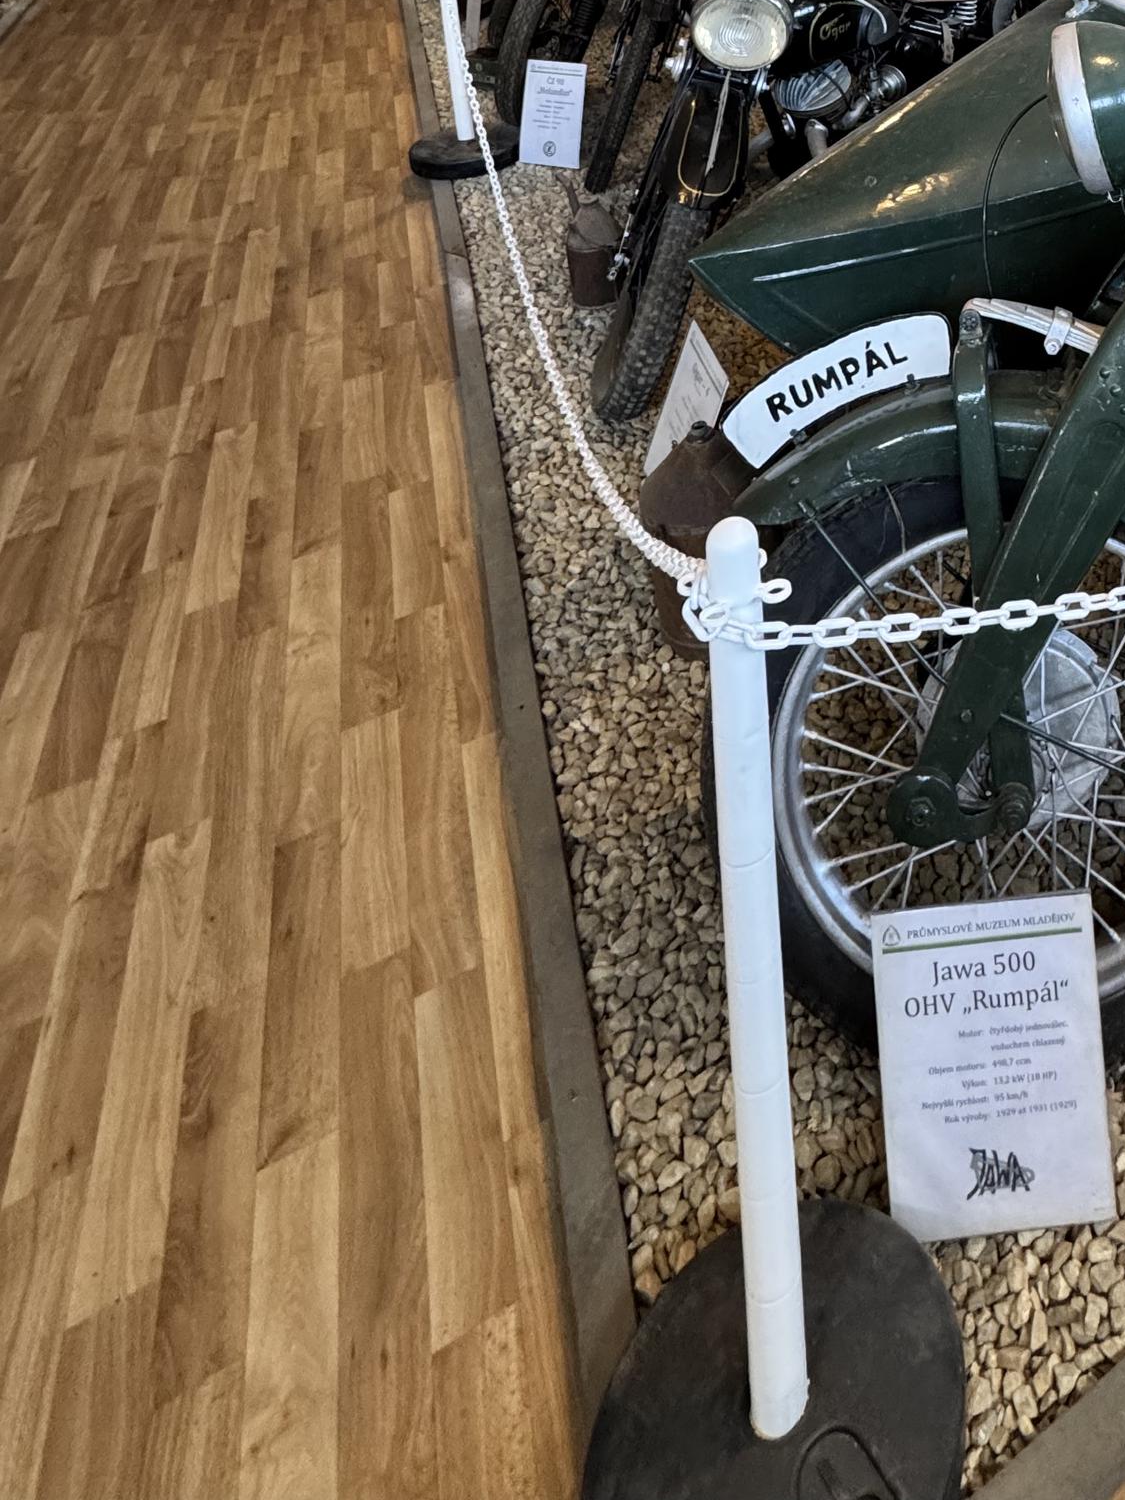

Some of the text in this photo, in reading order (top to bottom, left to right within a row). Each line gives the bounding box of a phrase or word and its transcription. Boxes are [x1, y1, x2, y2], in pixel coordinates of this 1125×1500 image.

[820, 13, 851, 41] Ogar
[765, 341, 908, 422] RUMPÁL
[907, 912, 1076, 939] PRŮMYSLOVÉ MUZEUM MLADĚJOV
[932, 951, 1036, 987] Jawa 500
[904, 979, 1069, 1018] OHV „Rumpál“
[967, 1148, 1031, 1201] JAWA
